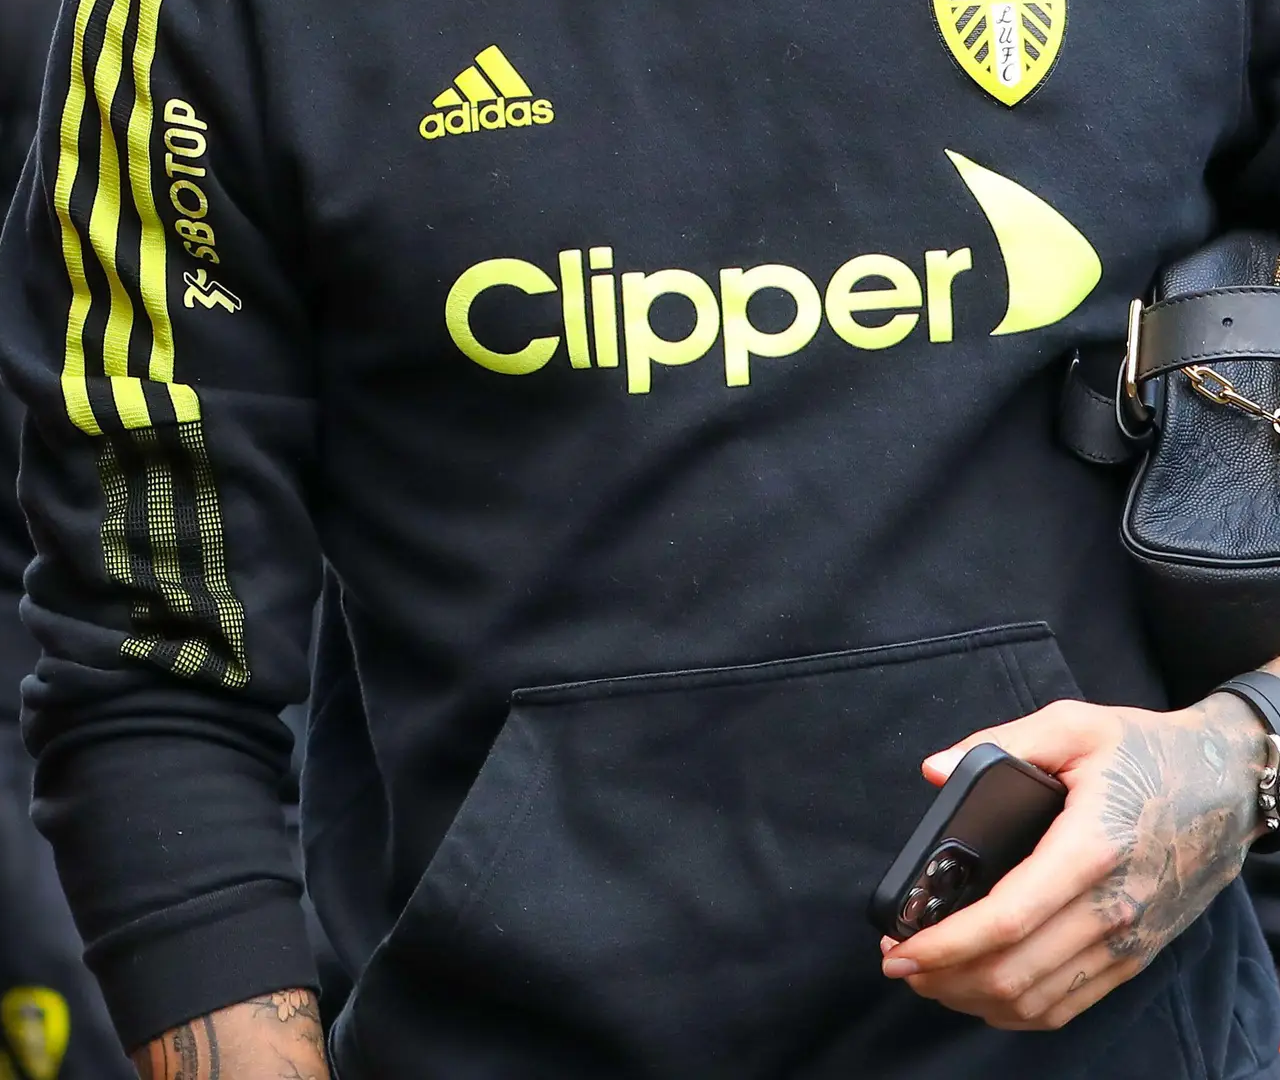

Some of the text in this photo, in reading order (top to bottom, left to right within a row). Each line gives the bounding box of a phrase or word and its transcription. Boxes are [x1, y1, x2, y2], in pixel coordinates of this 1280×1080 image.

[996, 5, 1016, 82] LUFC
[418, 97, 556, 140] adidas
[163, 97, 220, 264] SBOTOP
[444, 246, 974, 395] Clipper
